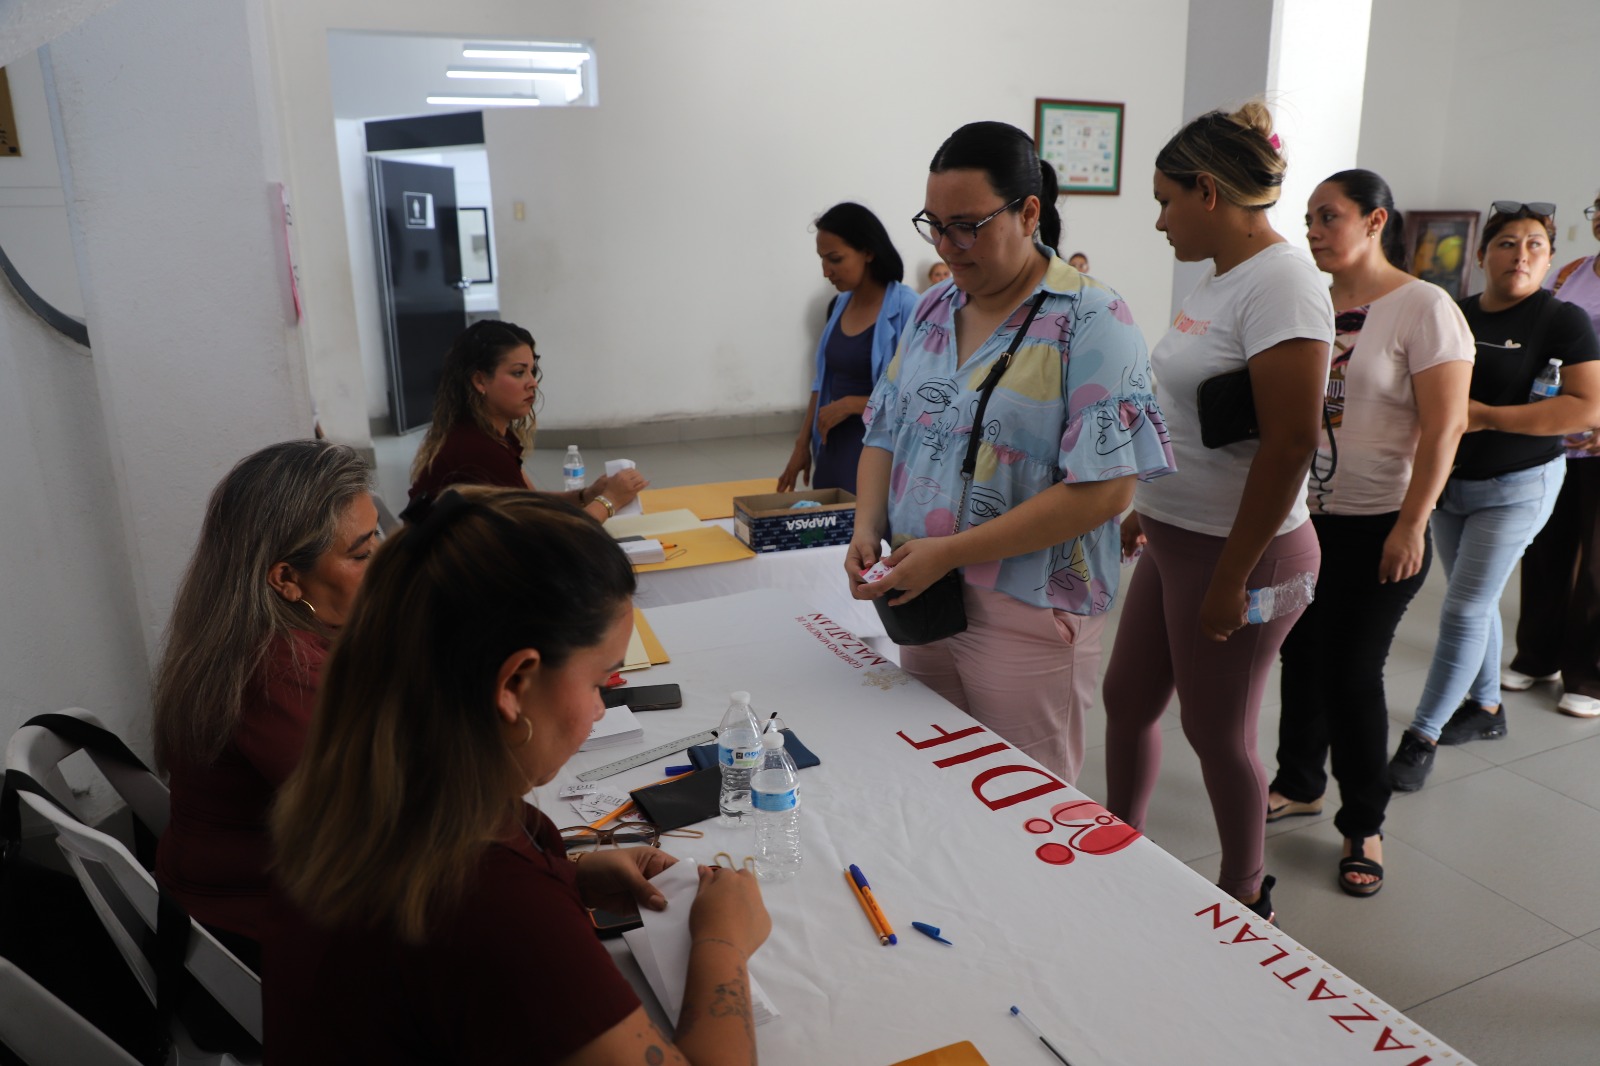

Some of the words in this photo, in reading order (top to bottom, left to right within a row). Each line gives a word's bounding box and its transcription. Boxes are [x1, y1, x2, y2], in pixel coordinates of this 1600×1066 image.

[786, 516, 836, 530] MAPASA
[896, 724, 1067, 811] DIF
[1194, 903, 1433, 1066] AZATLÁN
[1295, 946, 1343, 979] PARA
